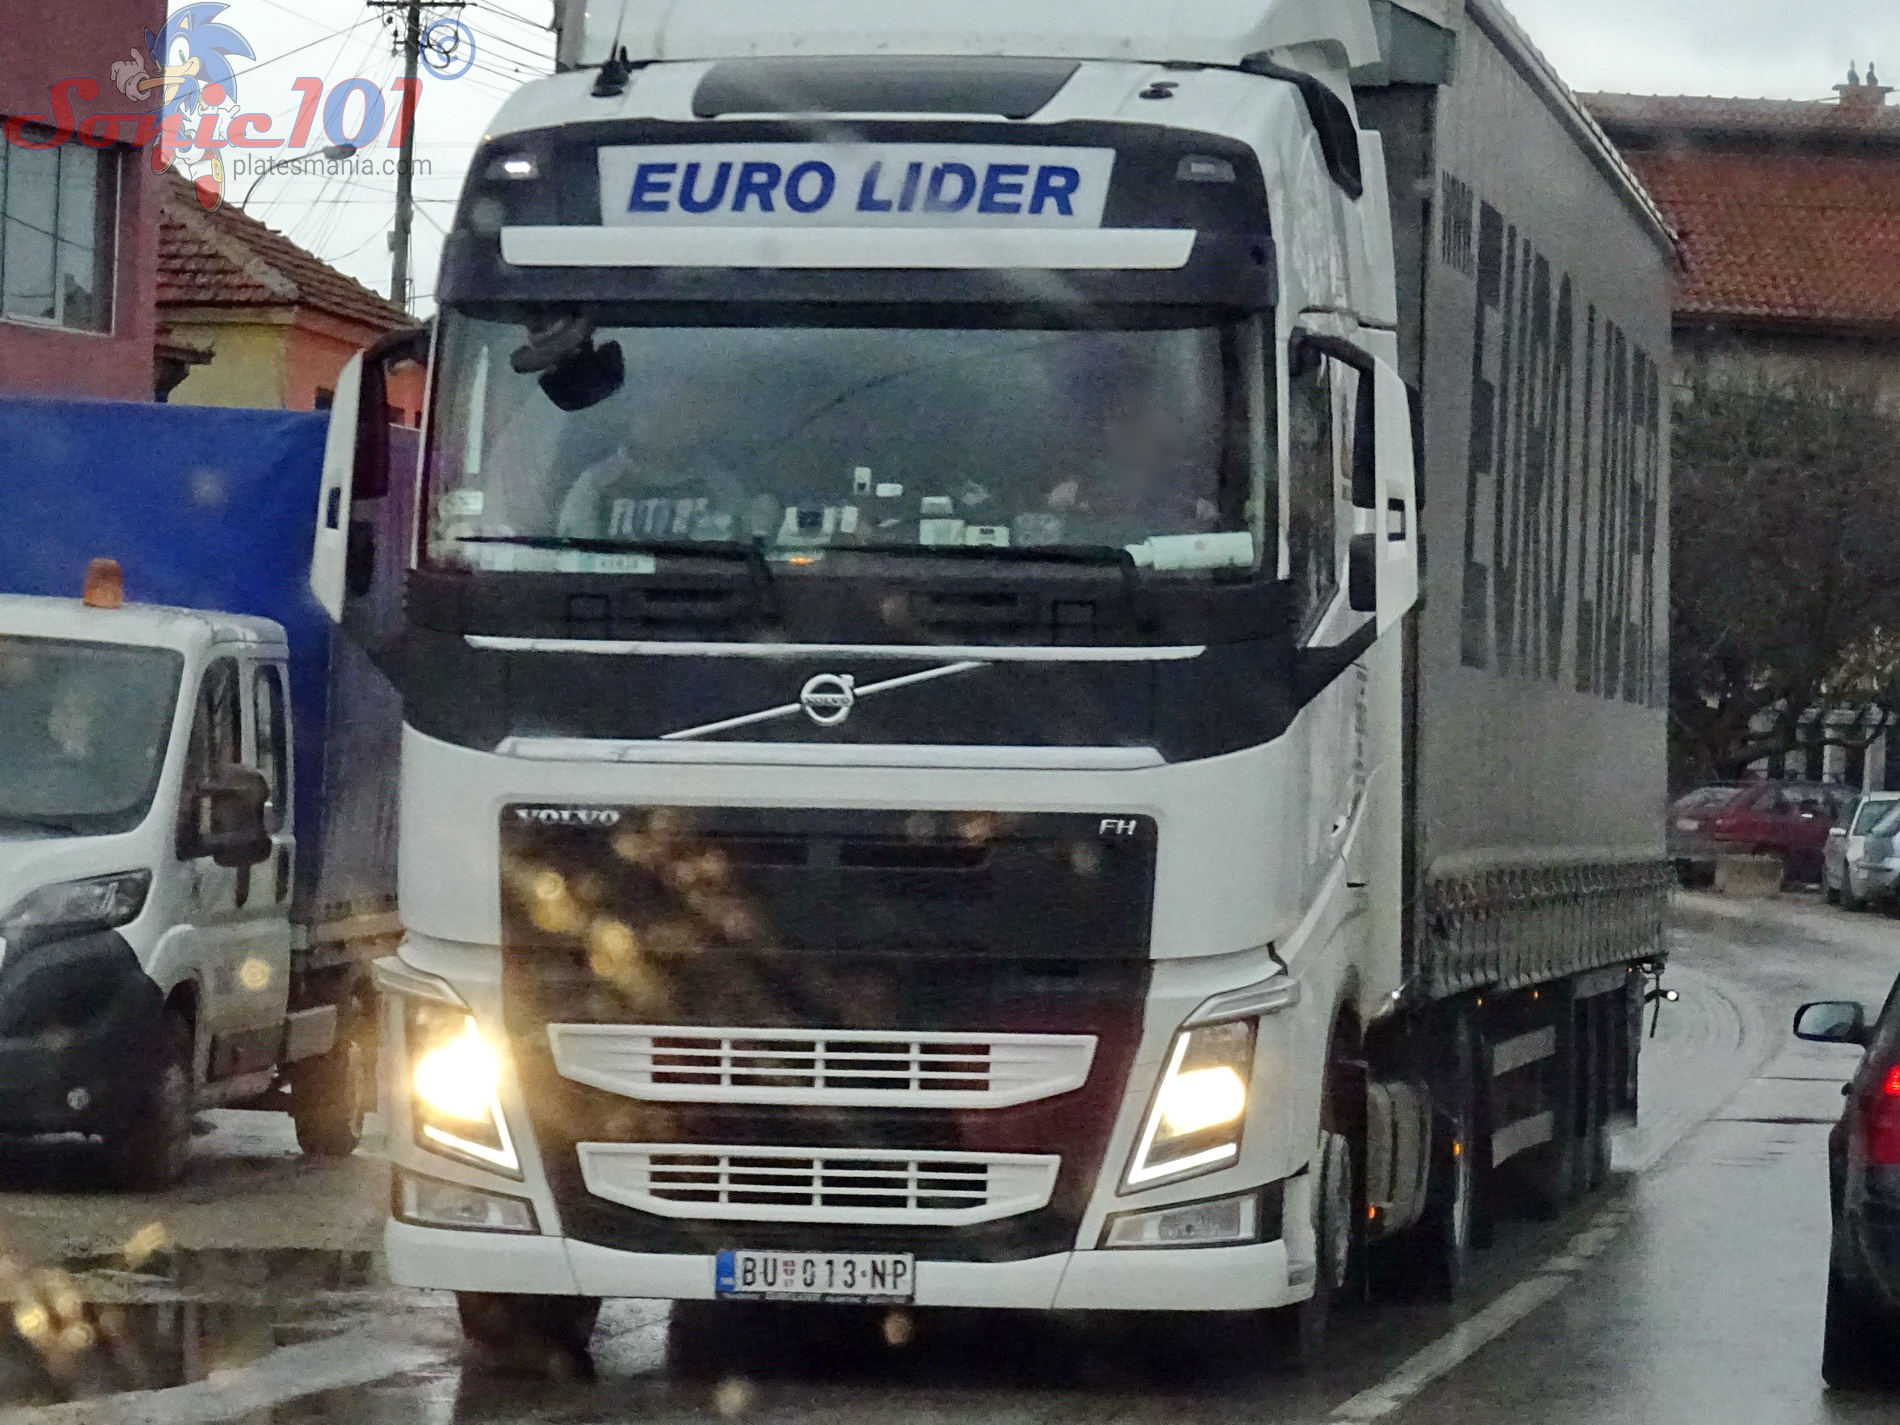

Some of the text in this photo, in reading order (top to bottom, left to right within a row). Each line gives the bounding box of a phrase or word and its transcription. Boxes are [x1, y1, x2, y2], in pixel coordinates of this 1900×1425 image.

[627, 161, 1080, 215] EURO LIDER
[1099, 818, 1137, 835] FH
[742, 1257, 778, 1287] BU
